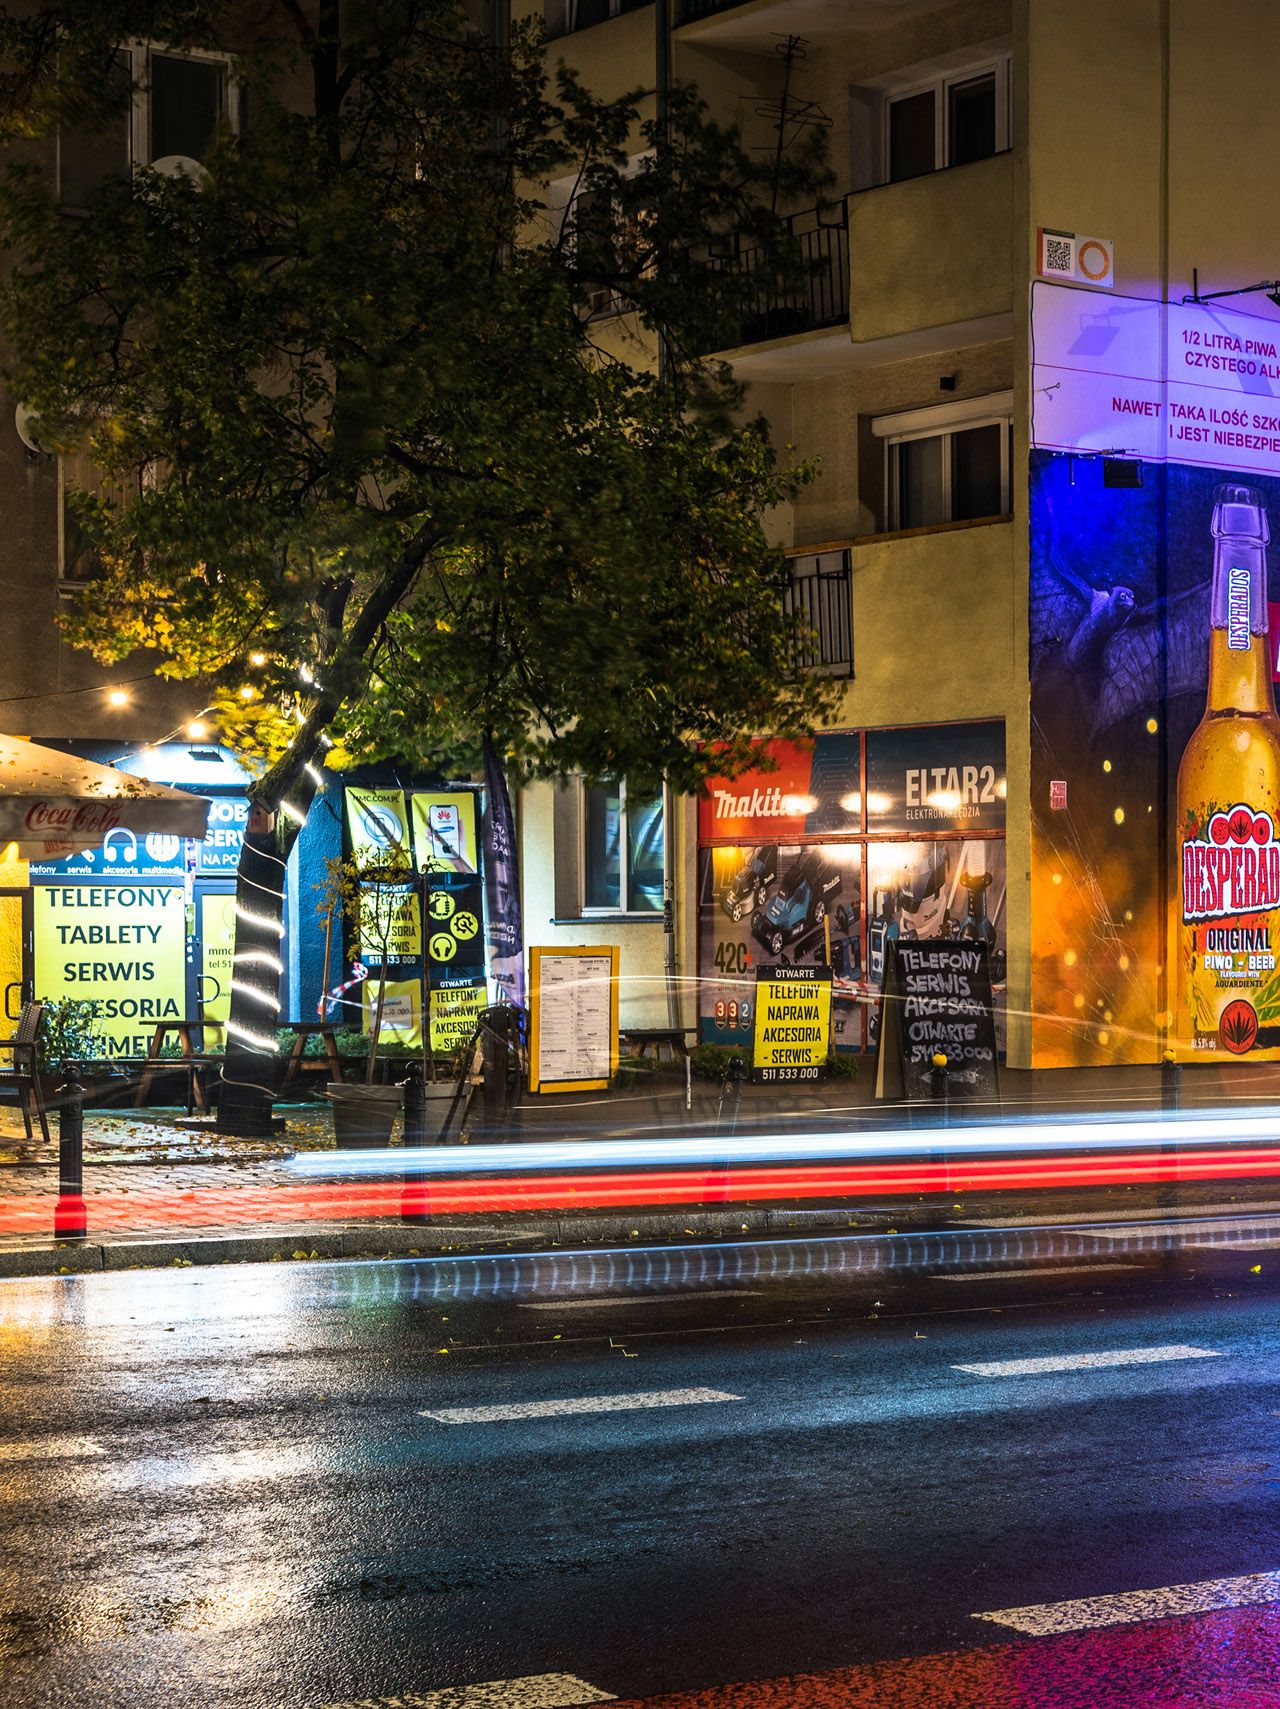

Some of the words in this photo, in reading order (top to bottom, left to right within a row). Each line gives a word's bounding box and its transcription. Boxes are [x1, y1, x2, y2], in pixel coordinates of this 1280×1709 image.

[1182, 329, 1200, 345] 1/2
[1203, 332, 1242, 352] LITRA
[1245, 340, 1277, 359] PIWA
[1185, 351, 1257, 376] CZYSTEGO
[1112, 397, 1162, 417] NAWET
[1170, 403, 1206, 422] TAKA
[1209, 409, 1249, 428] ILOŚĆ
[1177, 426, 1210, 443] JEST
[1229, 568, 1251, 650] DESPERADOS
[906, 765, 995, 807] ELTAR2
[202, 853, 221, 865] NA
[28, 865, 57, 877] elefony
[66, 866, 92, 875] serwis
[102, 865, 138, 875] akcesoria
[45, 888, 172, 907] TELEFONY
[56, 925, 162, 944] TABLETY
[1206, 927, 1271, 953] ORIGINAL
[899, 949, 981, 974] TELEFONY
[1204, 954, 1233, 970] PIWO
[1248, 954, 1275, 970] BEER
[63, 962, 155, 982] SERWIS
[776, 969, 815, 978] OTWARTE
[440, 980, 473, 988] OTWARTE
[769, 984, 821, 999] TELEFONY
[906, 973, 971, 996] SERWIS
[1215, 980, 1264, 988] AGUARDIENTE
[435, 990, 478, 1003] TELEFONY
[436, 1005, 480, 1019] NAPRAWA
[717, 1002, 724, 1017] 3
[729, 1002, 736, 1017] 3
[742, 1003, 748, 1017] 2
[768, 1006, 819, 1021] NAPRAWA
[763, 1027, 821, 1042] AKCESORIA
[909, 1020, 977, 1042] OTWARTE
[772, 1048, 812, 1063] SERWIS
[762, 1069, 776, 1080] 511
[779, 1068, 797, 1079] 533
[800, 1067, 819, 1079] 000
